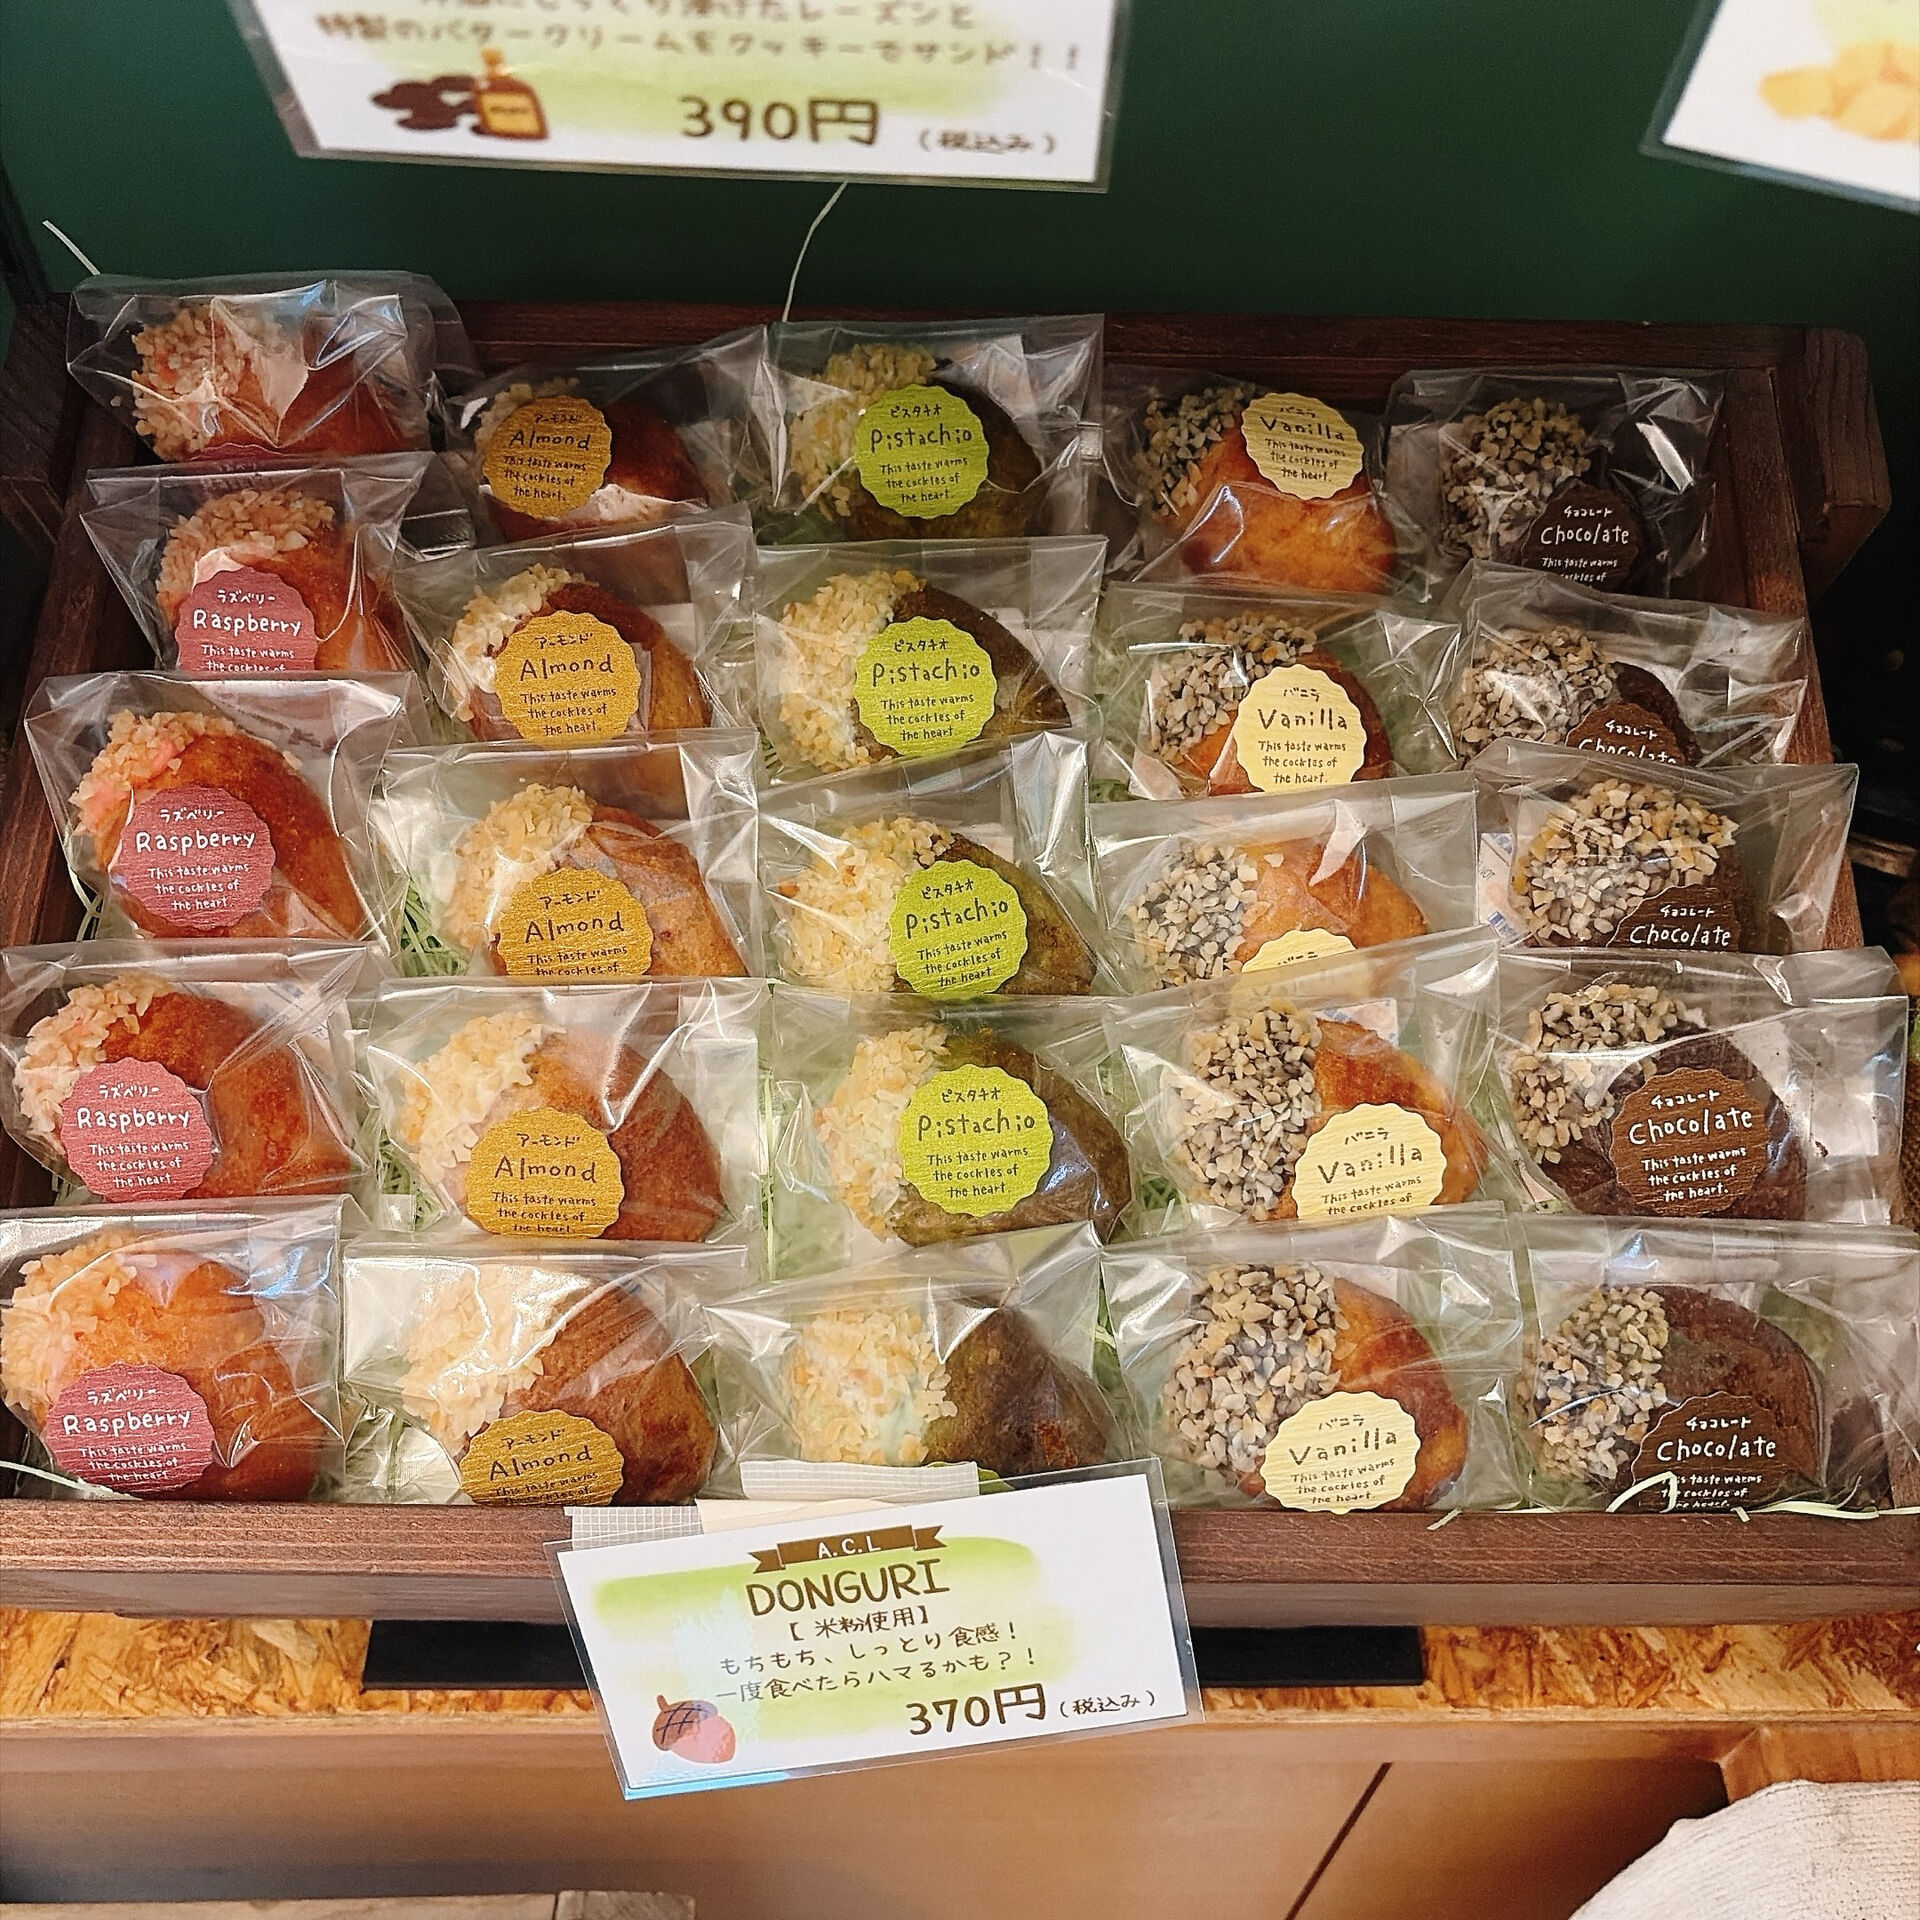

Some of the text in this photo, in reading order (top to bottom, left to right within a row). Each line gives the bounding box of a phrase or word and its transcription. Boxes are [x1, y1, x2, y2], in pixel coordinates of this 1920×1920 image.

[679, 95, 880, 147] 390円
[890, 404, 941, 418] ピスタチオ
[871, 423, 972, 453] Pistachio
[1259, 416, 1345, 441] Vanilla
[509, 429, 590, 451] Almond
[881, 457, 968, 475] This taste warms
[885, 472, 960, 489] the cockles of
[901, 493, 917, 503] the
[1563, 505, 1613, 518] チョコレート
[1540, 523, 1629, 545] Chocolate
[217, 589, 276, 604] ラズベリー
[193, 609, 301, 636] Raspberry
[534, 632, 593, 649] アーモンド
[894, 638, 949, 652] ピスタチオ
[201, 644, 294, 659] This taste warms
[520, 654, 614, 681] Almond
[872, 658, 980, 687] Pistachio
[520, 688, 617, 705] This taste warms
[880, 694, 974, 710] This taste warms
[1283, 687, 1320, 702] バニラ
[527, 703, 608, 719] the cockles of
[886, 709, 965, 725] the cockles of
[1257, 708, 1347, 730] Vanilla
[543, 725, 563, 736] the
[900, 730, 919, 741] the
[1605, 719, 1658, 740] チョコレート
[1258, 740, 1346, 752] This taste warms
[1262, 756, 1338, 767] the cockles of
[1273, 772, 1290, 784] the
[160, 808, 224, 823] ラズベリー
[135, 829, 255, 856] Raspberry
[147, 863, 249, 879] This taste warms
[155, 879, 240, 895] the cockles of
[921, 878, 974, 900] ピスタチオ
[171, 901, 191, 911] the
[539, 890, 600, 909] アーモンド
[906, 897, 1008, 939] Pistachio
[1660, 904, 1715, 918] チョコレート
[525, 911, 625, 943] Almond
[1629, 923, 1731, 947] Chocolate
[917, 930, 1007, 960] This taste warms
[527, 945, 628, 966] This taste warms
[924, 948, 1001, 975] the cockles of
[939, 976, 956, 987] the
[99, 1082, 159, 1099] ラズベリー
[942, 1086, 1001, 1103] ピスタチオ
[1651, 1089, 1720, 1110] チョコレート
[77, 1107, 189, 1133] Raspberry
[918, 1108, 1035, 1142] Pistachio
[1629, 1107, 1752, 1145] Chocolate
[516, 1133, 580, 1147] アーモンド
[1345, 1127, 1390, 1144] バニラ
[88, 1141, 189, 1156] This taste warms
[926, 1147, 1028, 1166] This taste warms
[96, 1156, 182, 1171] the cockles of
[494, 1155, 597, 1183] Almond
[1317, 1142, 1422, 1183] Vanilla
[1641, 1147, 1747, 1172] This taste warms
[932, 1163, 1019, 1181] the cockles of
[1648, 1163, 1737, 1186] the cockles of
[113, 1177, 133, 1188] the
[948, 1186, 968, 1198] the
[1322, 1176, 1421, 1205] This taste warms
[1663, 1182, 1729, 1202] the heart.
[492, 1191, 596, 1206] This taste warms
[1327, 1193, 1412, 1216] the cockles of
[497, 1208, 585, 1222] the cockles of
[87, 1388, 156, 1405] ラズベリー
[63, 1411, 191, 1437] Raspberry
[1318, 1414, 1364, 1430] バニラ
[1686, 1416, 1751, 1431] チョコレート
[501, 1428, 565, 1450] アーモンド
[1289, 1428, 1397, 1465] Vanilla
[1657, 1434, 1776, 1461] Chocolate
[489, 1444, 593, 1481] Almond
[1291, 1458, 1395, 1484] This taste warms
[1296, 1484, 1316, 1494] the
[1373, 1475, 1386, 1485] of
[818, 1535, 881, 1559] A.C.L
[746, 1558, 950, 1616] DONGURI
[906, 1683, 1045, 1735] 370円
